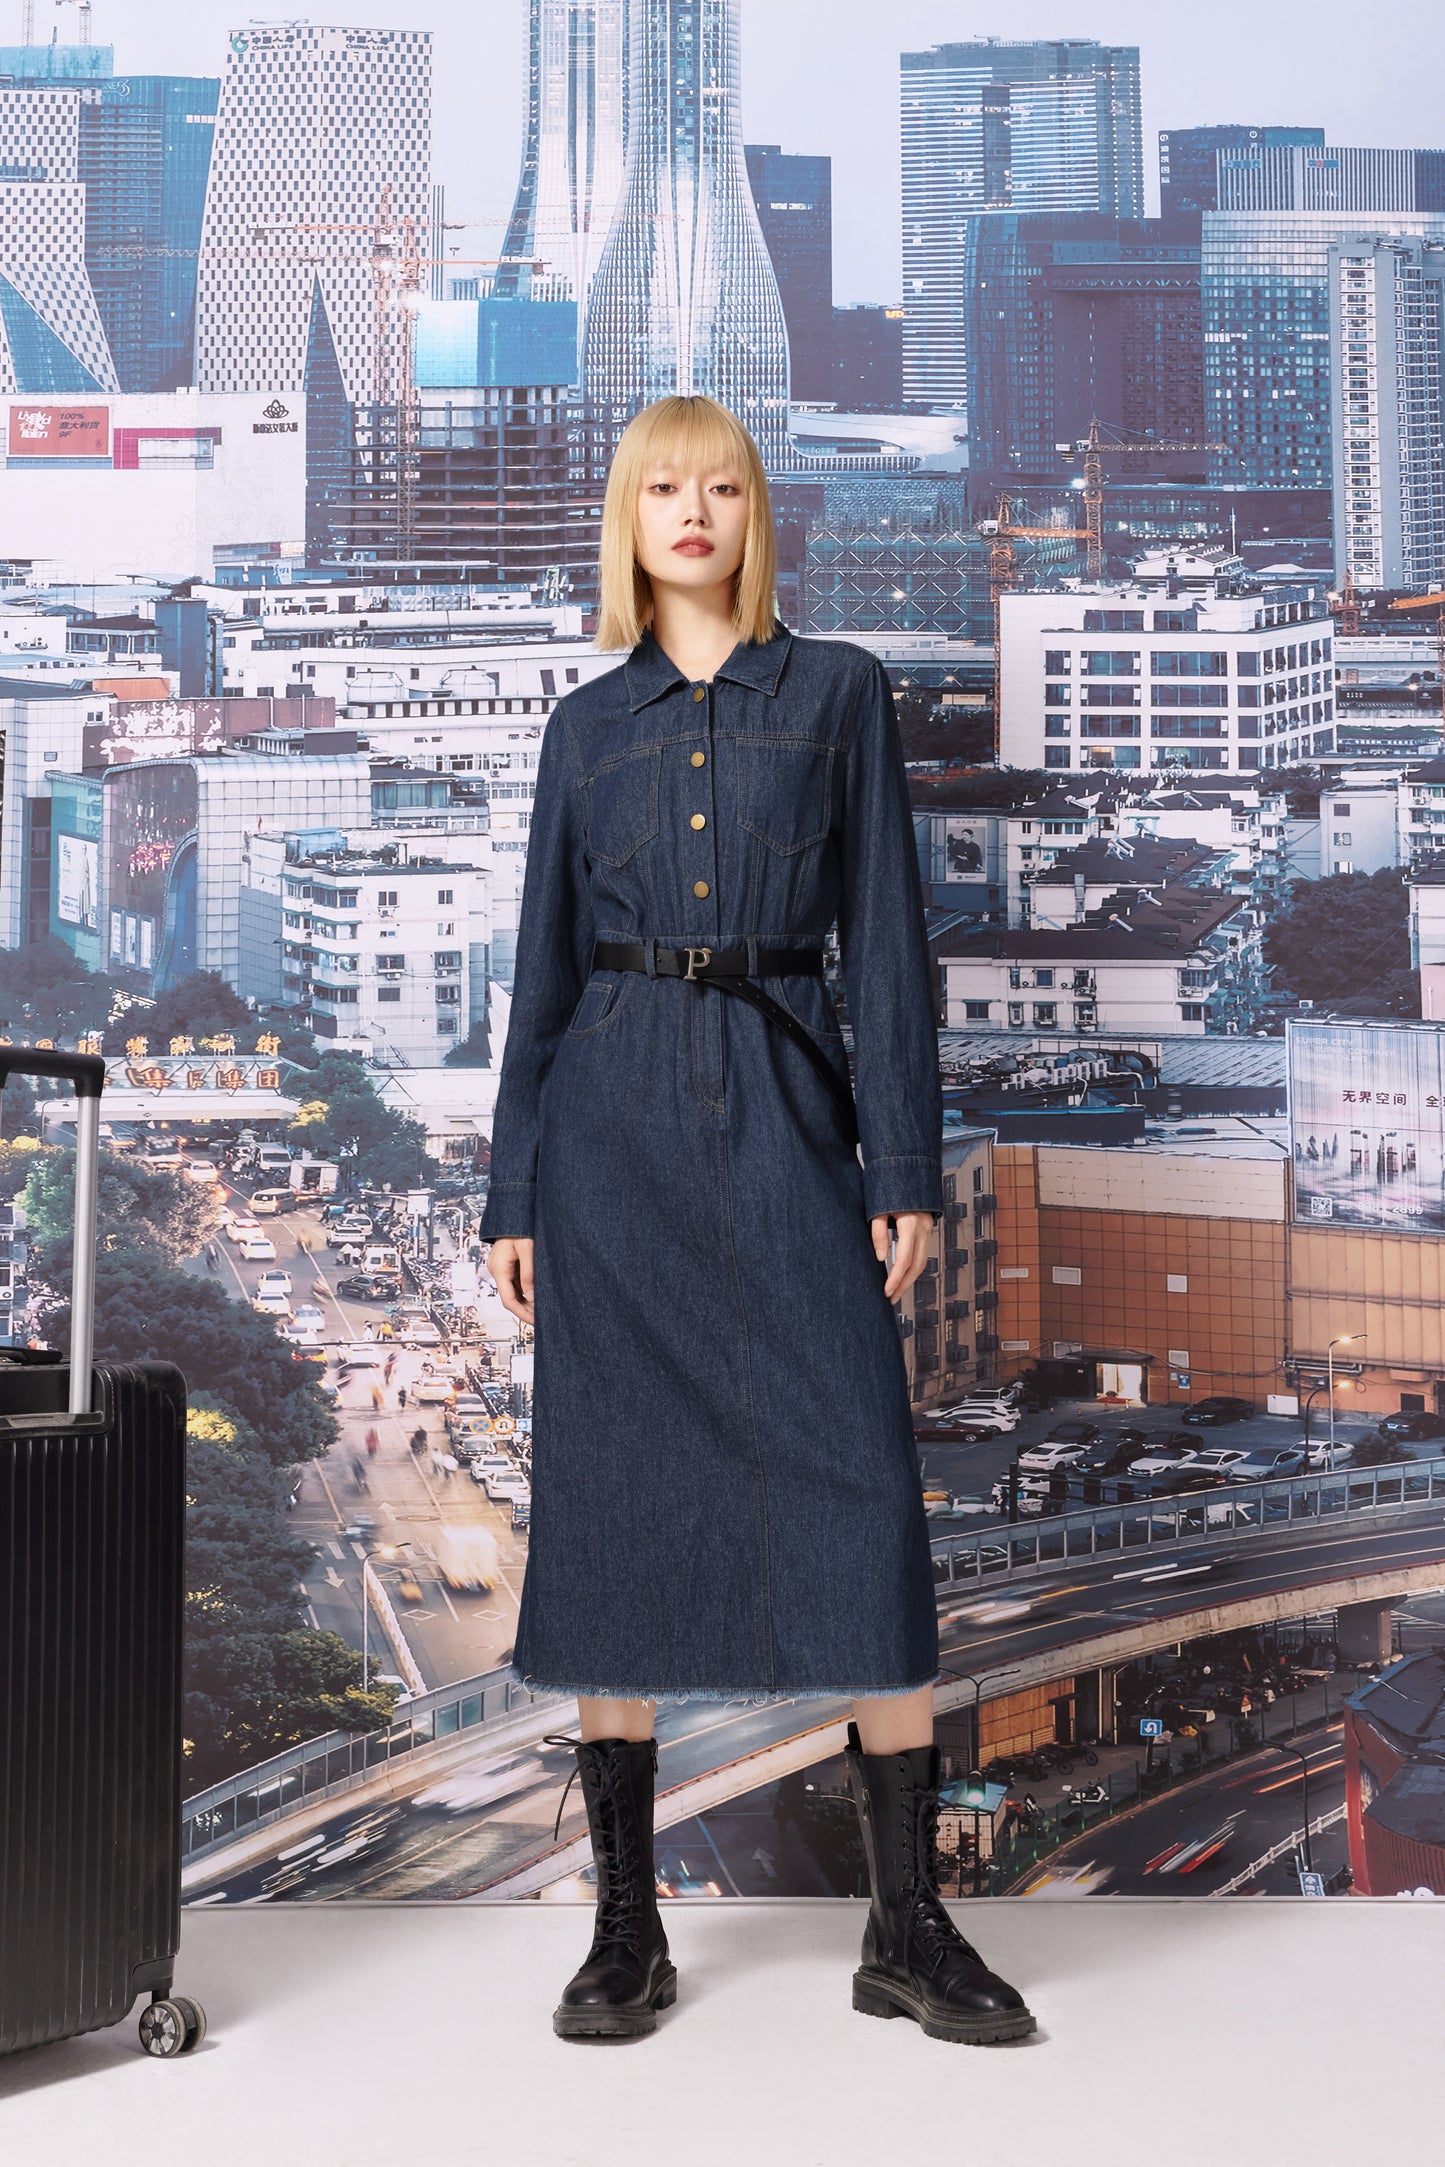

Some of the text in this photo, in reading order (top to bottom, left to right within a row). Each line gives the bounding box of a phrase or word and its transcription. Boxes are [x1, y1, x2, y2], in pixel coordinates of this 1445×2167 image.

[60, 412, 84, 420] 100%
[684, 948, 710, 980] P
[1342, 1089, 1407, 1106] 无界空间
